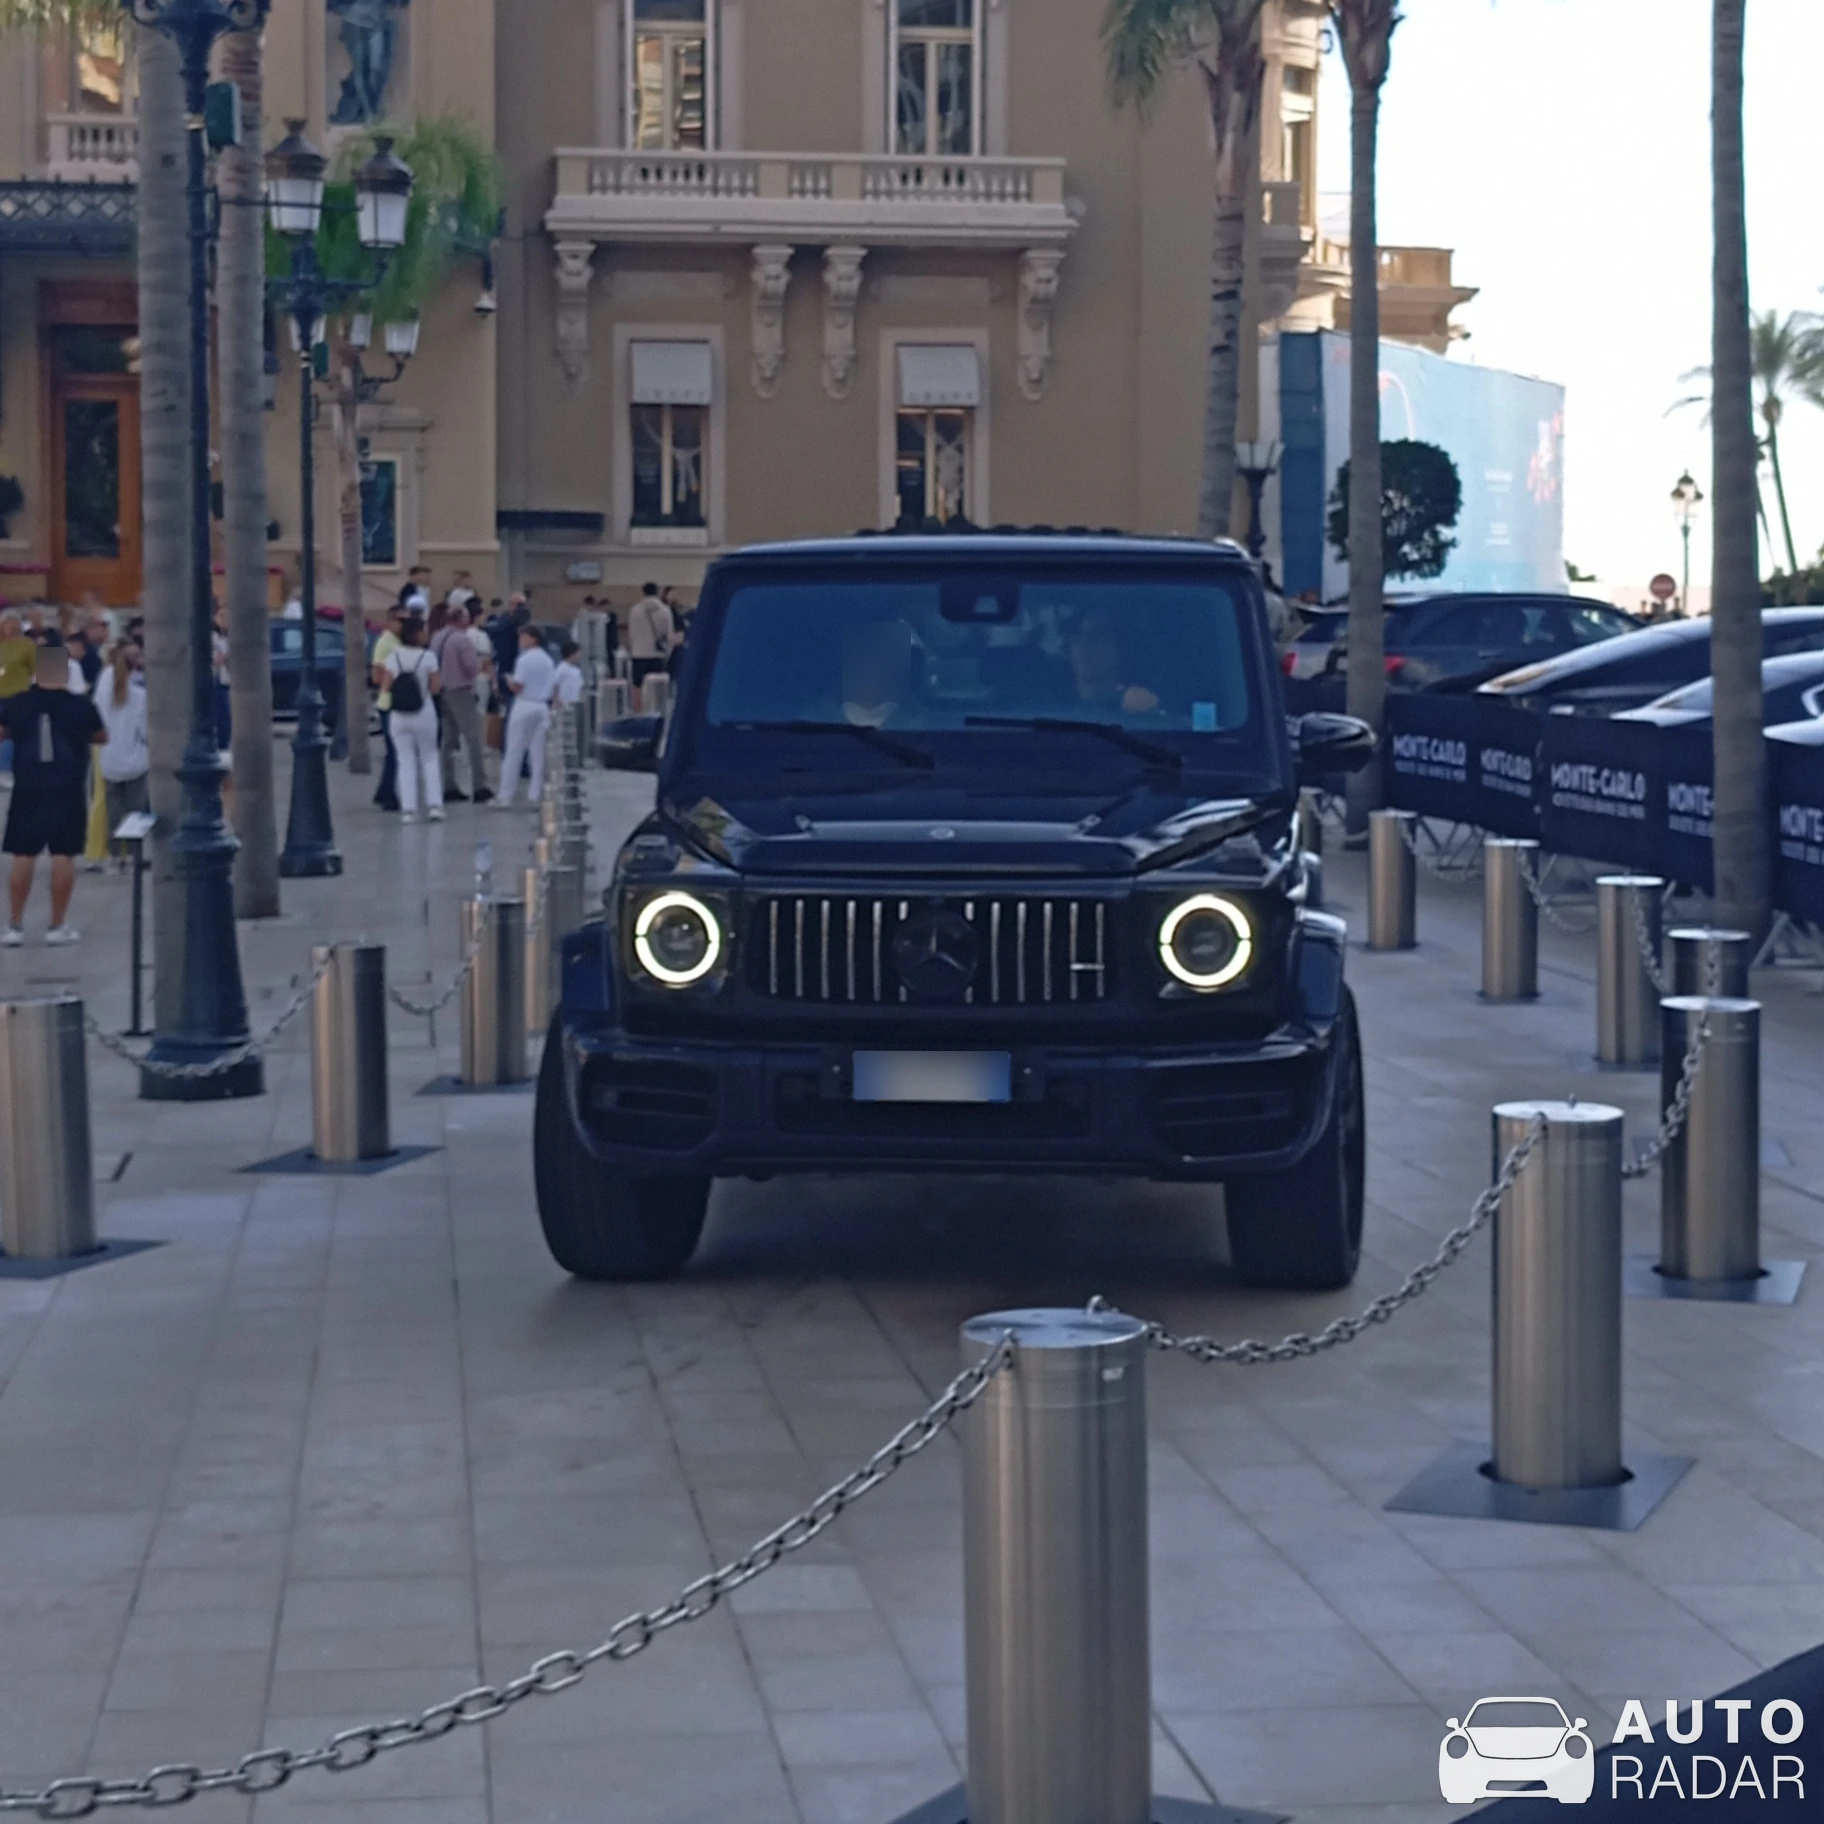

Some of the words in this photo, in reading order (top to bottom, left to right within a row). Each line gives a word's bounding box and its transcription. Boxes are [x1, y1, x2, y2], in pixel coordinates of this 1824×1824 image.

[1393, 734, 1466, 766] MONTE-CARLO
[1551, 762, 1646, 801] MONTE-CARLO
[1668, 782, 1713, 816] MONTE-
